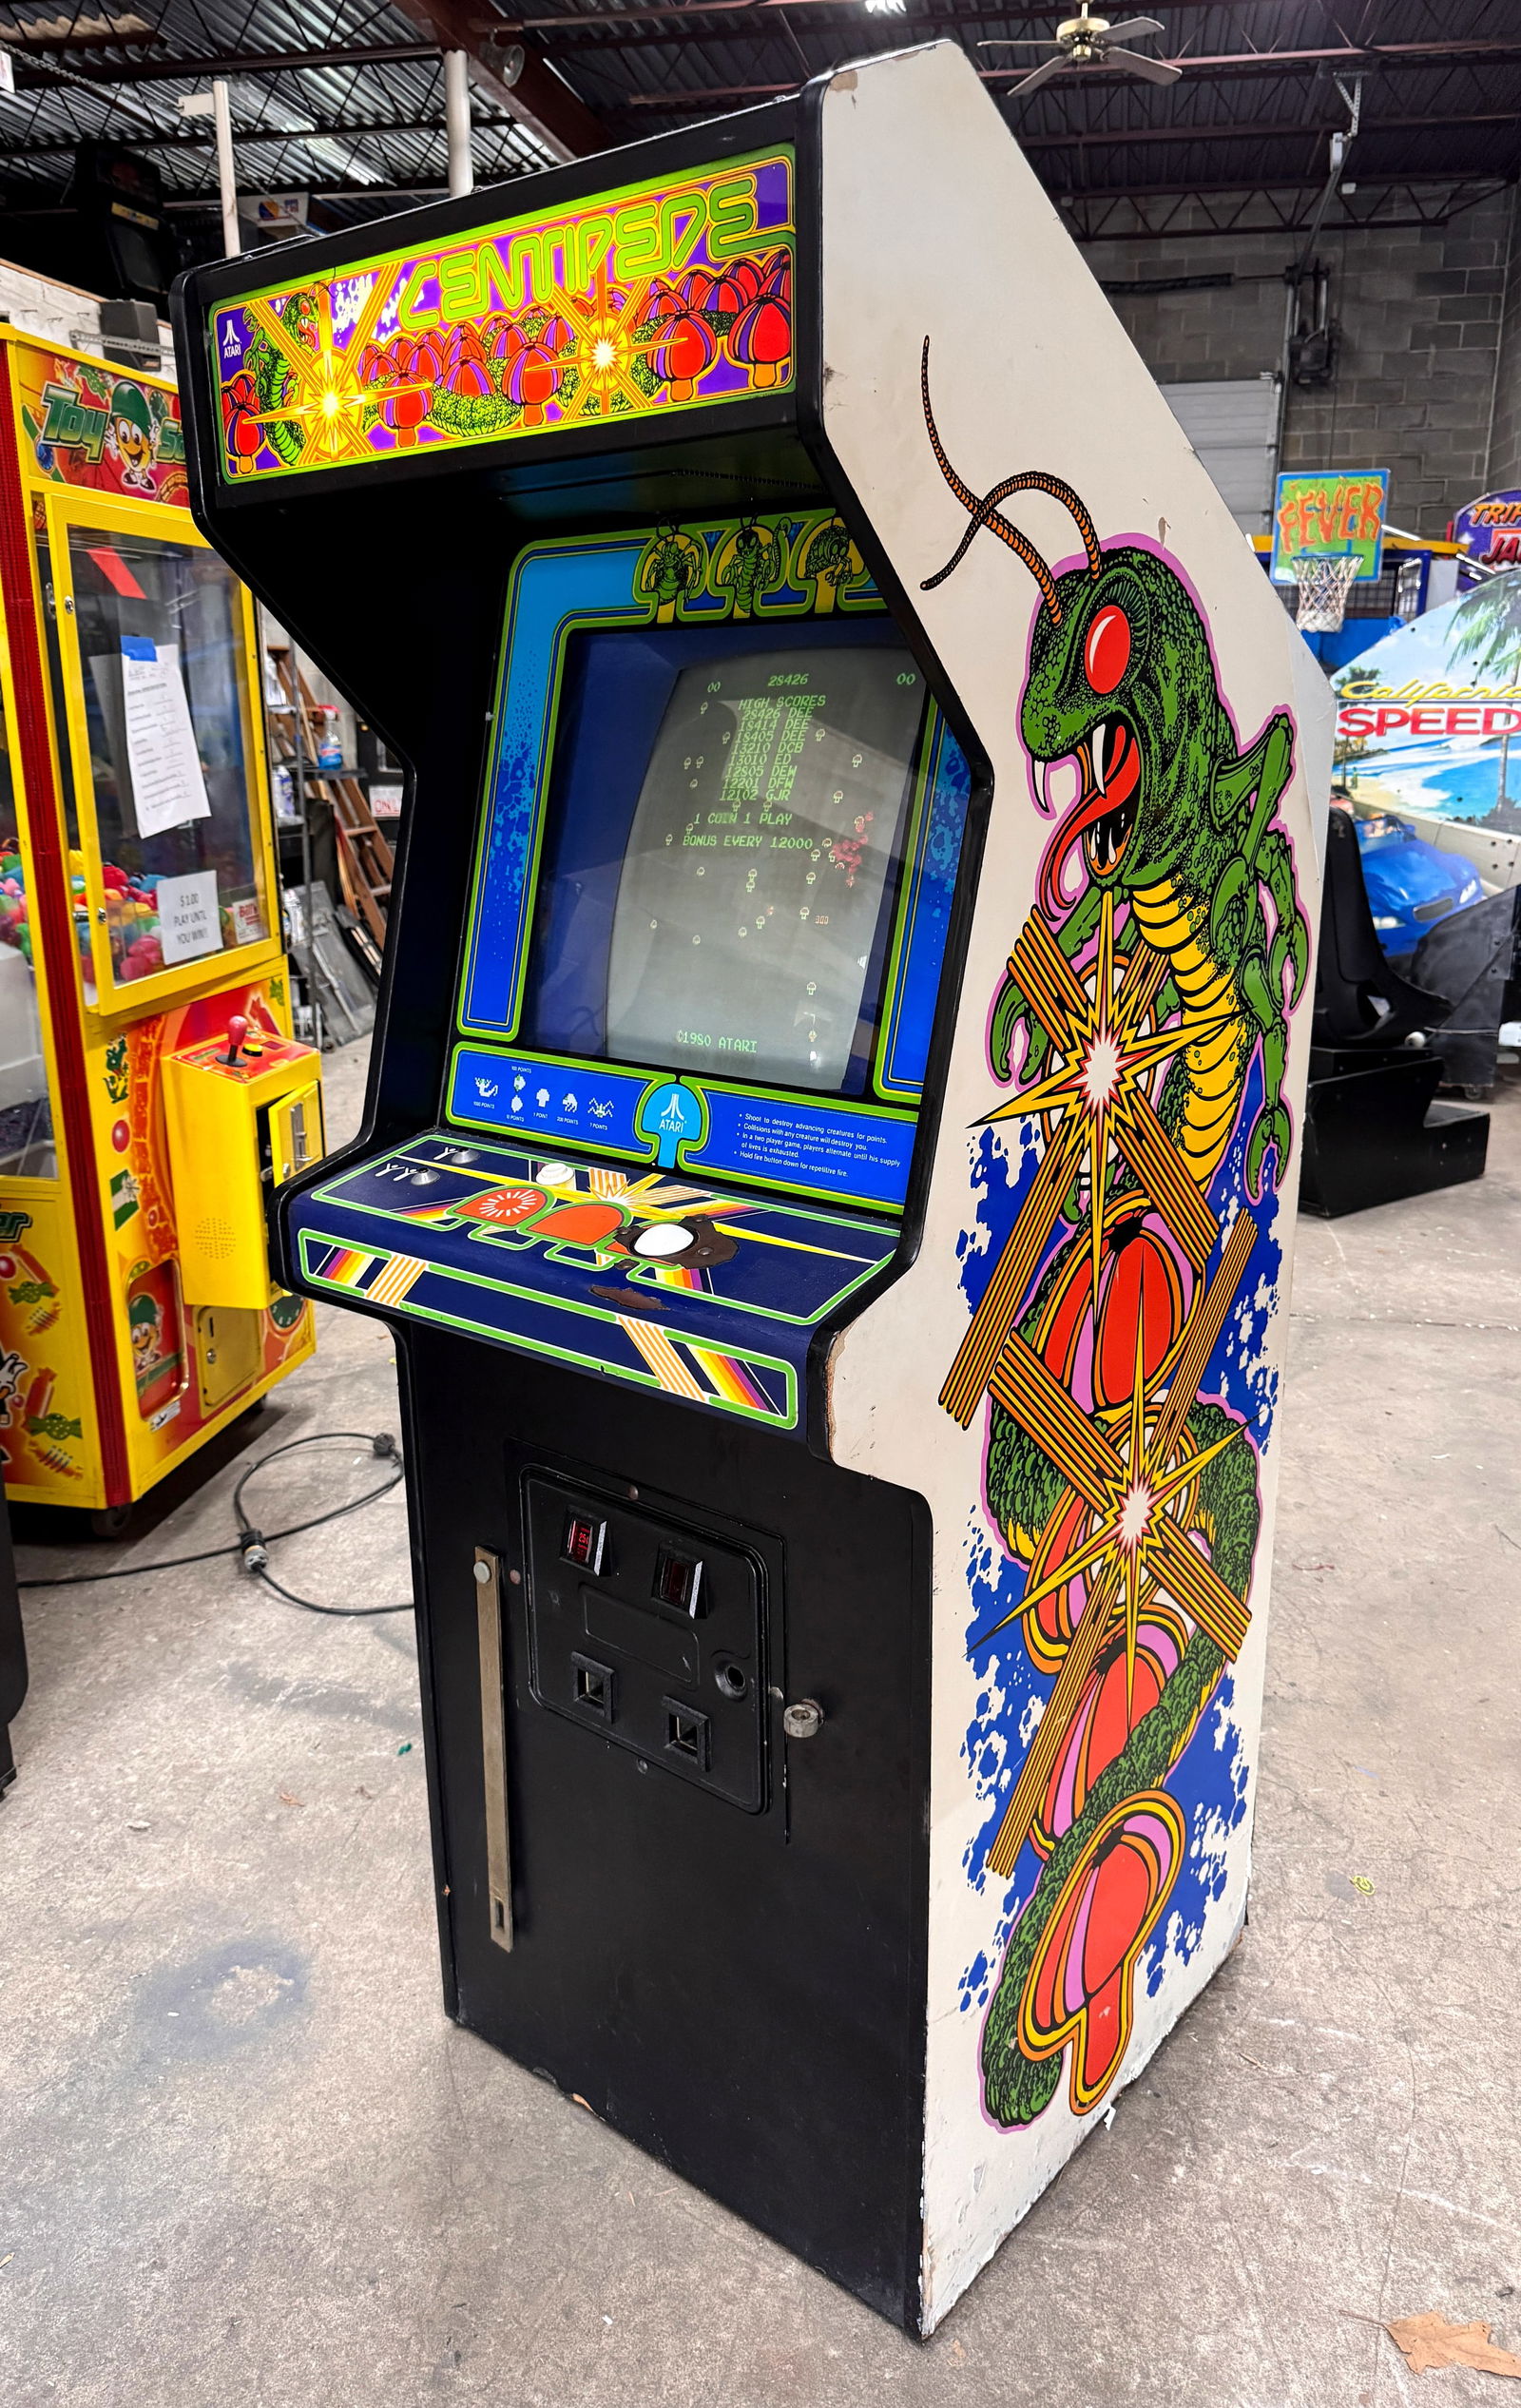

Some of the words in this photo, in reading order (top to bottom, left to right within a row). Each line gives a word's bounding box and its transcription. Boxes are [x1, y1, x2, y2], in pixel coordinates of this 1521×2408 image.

[398, 176, 760, 330] CENTIPEDE
[223, 343, 241, 359] ATARI
[43, 383, 108, 464] Toy
[1278, 481, 1384, 553] FEVER
[707, 682, 721, 693] 00
[767, 673, 809, 686] 28426
[896, 673, 915, 685] 00
[1340, 679, 1521, 708] California
[738, 696, 771, 710] HIGH
[776, 695, 826, 708] SCORES
[741, 707, 780, 721] 28426
[788, 706, 814, 718] DEE
[739, 719, 778, 732] 18414
[784, 718, 811, 730] DEE
[1338, 708, 1521, 737] SPEED
[735, 730, 774, 743] 18405
[780, 729, 808, 742] DEE
[731, 742, 771, 755] 13210
[777, 742, 804, 753] DCB
[728, 753, 767, 766] 13010
[774, 753, 792, 764] ED
[725, 765, 764, 778] 12805
[771, 764, 798, 777] DEW
[722, 777, 760, 789] 12201
[767, 777, 795, 789] DFW
[719, 789, 759, 800] 12102
[765, 789, 791, 800] GJR
[694, 813, 700, 824] 1
[707, 812, 738, 824] COIN
[743, 812, 751, 824] 1
[759, 813, 792, 826] PLAY
[682, 835, 717, 846] BONUS
[723, 835, 762, 847] EVERY
[769, 837, 814, 849] 12000
[718, 1036, 758, 1053] ATARI
[659, 1118, 683, 1133] ATARI
[744, 1112, 761, 1122] Shoot
[772, 1118, 793, 1128] destroy
[795, 1123, 825, 1134] advancing
[826, 1127, 855, 1138] creatures
[857, 1131, 866, 1140] for
[866, 1135, 888, 1144] points.
[743, 1123, 771, 1133] Collisions
[795, 1132, 819, 1142] creature
[830, 1138, 854, 1149] destroy
[765, 1137, 784, 1146] player
[784, 1141, 802, 1149] game,
[802, 1144, 824, 1152] players
[825, 1147, 852, 1158] alternate
[879, 1158, 900, 1167] supply
[768, 1147, 799, 1158] exhausted.
[740, 1150, 753, 1159] Hold
[763, 1155, 782, 1165] button
[808, 1165, 837, 1175] repetitive
[837, 1168, 849, 1177] fire.
